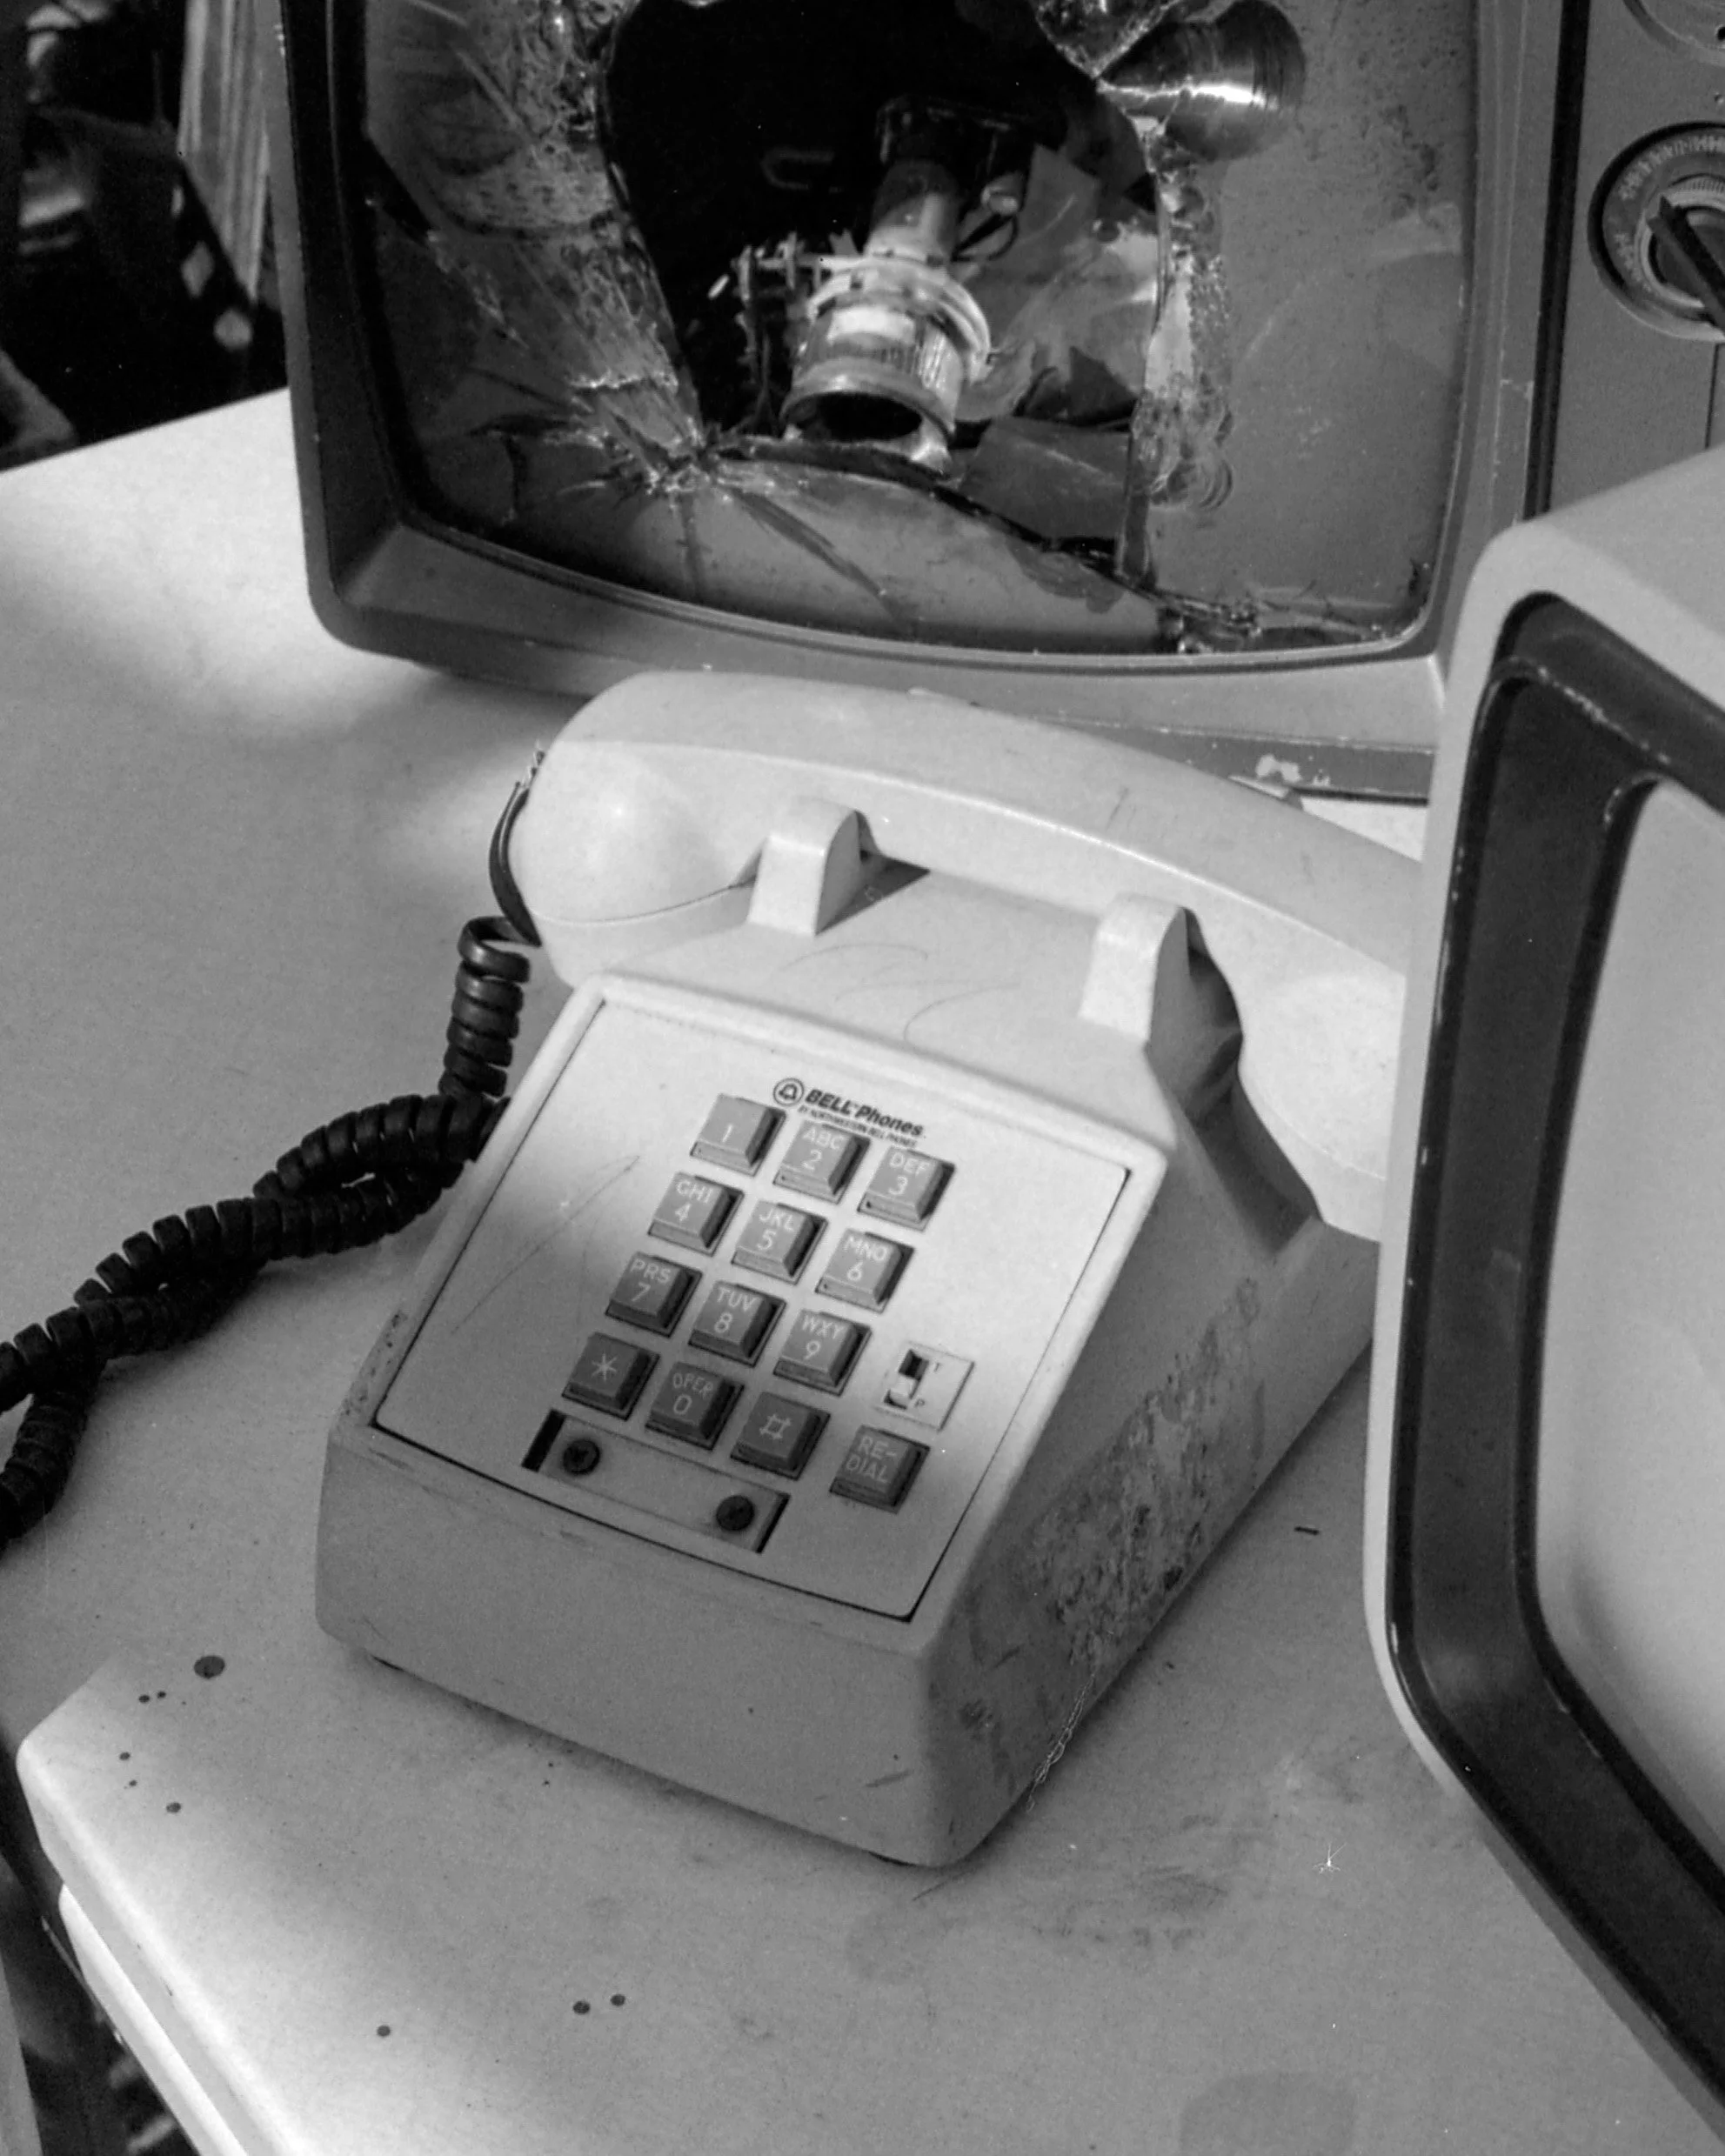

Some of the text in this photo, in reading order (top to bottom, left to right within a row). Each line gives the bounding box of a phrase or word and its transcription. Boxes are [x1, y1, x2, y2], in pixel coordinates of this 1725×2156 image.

[855, 1105, 924, 1137] Phones
[721, 1124, 732, 1143] 1
[803, 1125, 847, 1150] ABC
[802, 1151, 823, 1171] 2
[888, 1152, 933, 1176] DEF
[675, 1180, 713, 1203] GHI
[888, 1176, 908, 1196] 3
[673, 1203, 691, 1222] 4
[759, 1209, 795, 1232] JKL
[757, 1232, 777, 1251] 5
[845, 1236, 887, 1261] MNO
[630, 1259, 671, 1284] PRS
[846, 1261, 863, 1281] 6
[632, 1286, 648, 1302] 7
[716, 1288, 756, 1312] TUV
[713, 1313, 733, 1334] 8
[800, 1315, 846, 1339] WXY
[804, 1340, 820, 1361] 9
[672, 1372, 714, 1398] OPER
[672, 1397, 692, 1416] 0
[855, 1436, 898, 1458] RE-
[846, 1456, 889, 1485] DIAL
